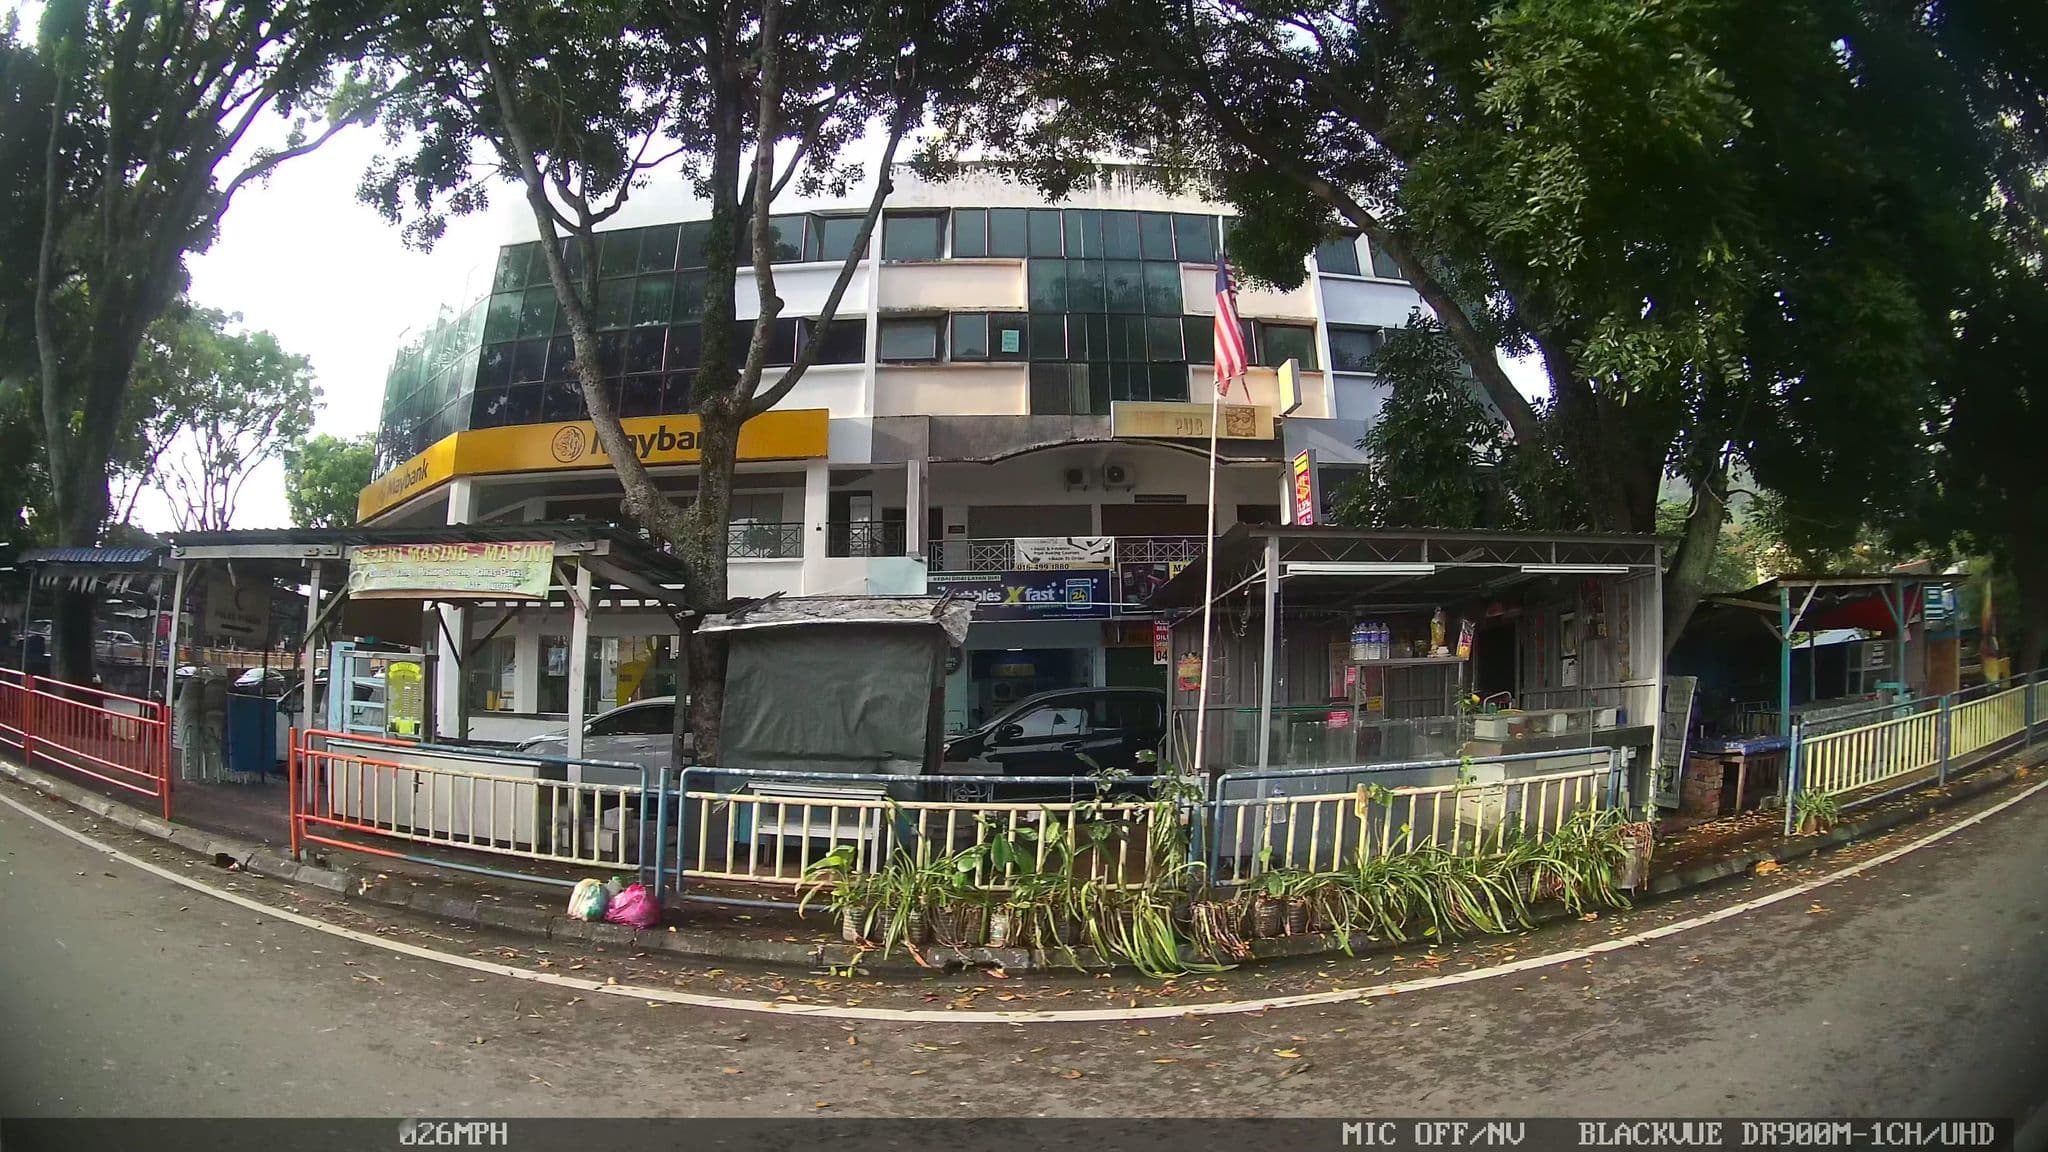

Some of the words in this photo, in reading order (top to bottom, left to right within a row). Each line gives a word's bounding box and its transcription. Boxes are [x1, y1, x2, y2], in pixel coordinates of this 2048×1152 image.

[591, 425, 703, 458] Myba
[387, 458, 429, 496] Maybank
[407, 545, 468, 563] MASING
[1025, 588, 1055, 601] fast
[1072, 588, 1087, 601] 24
